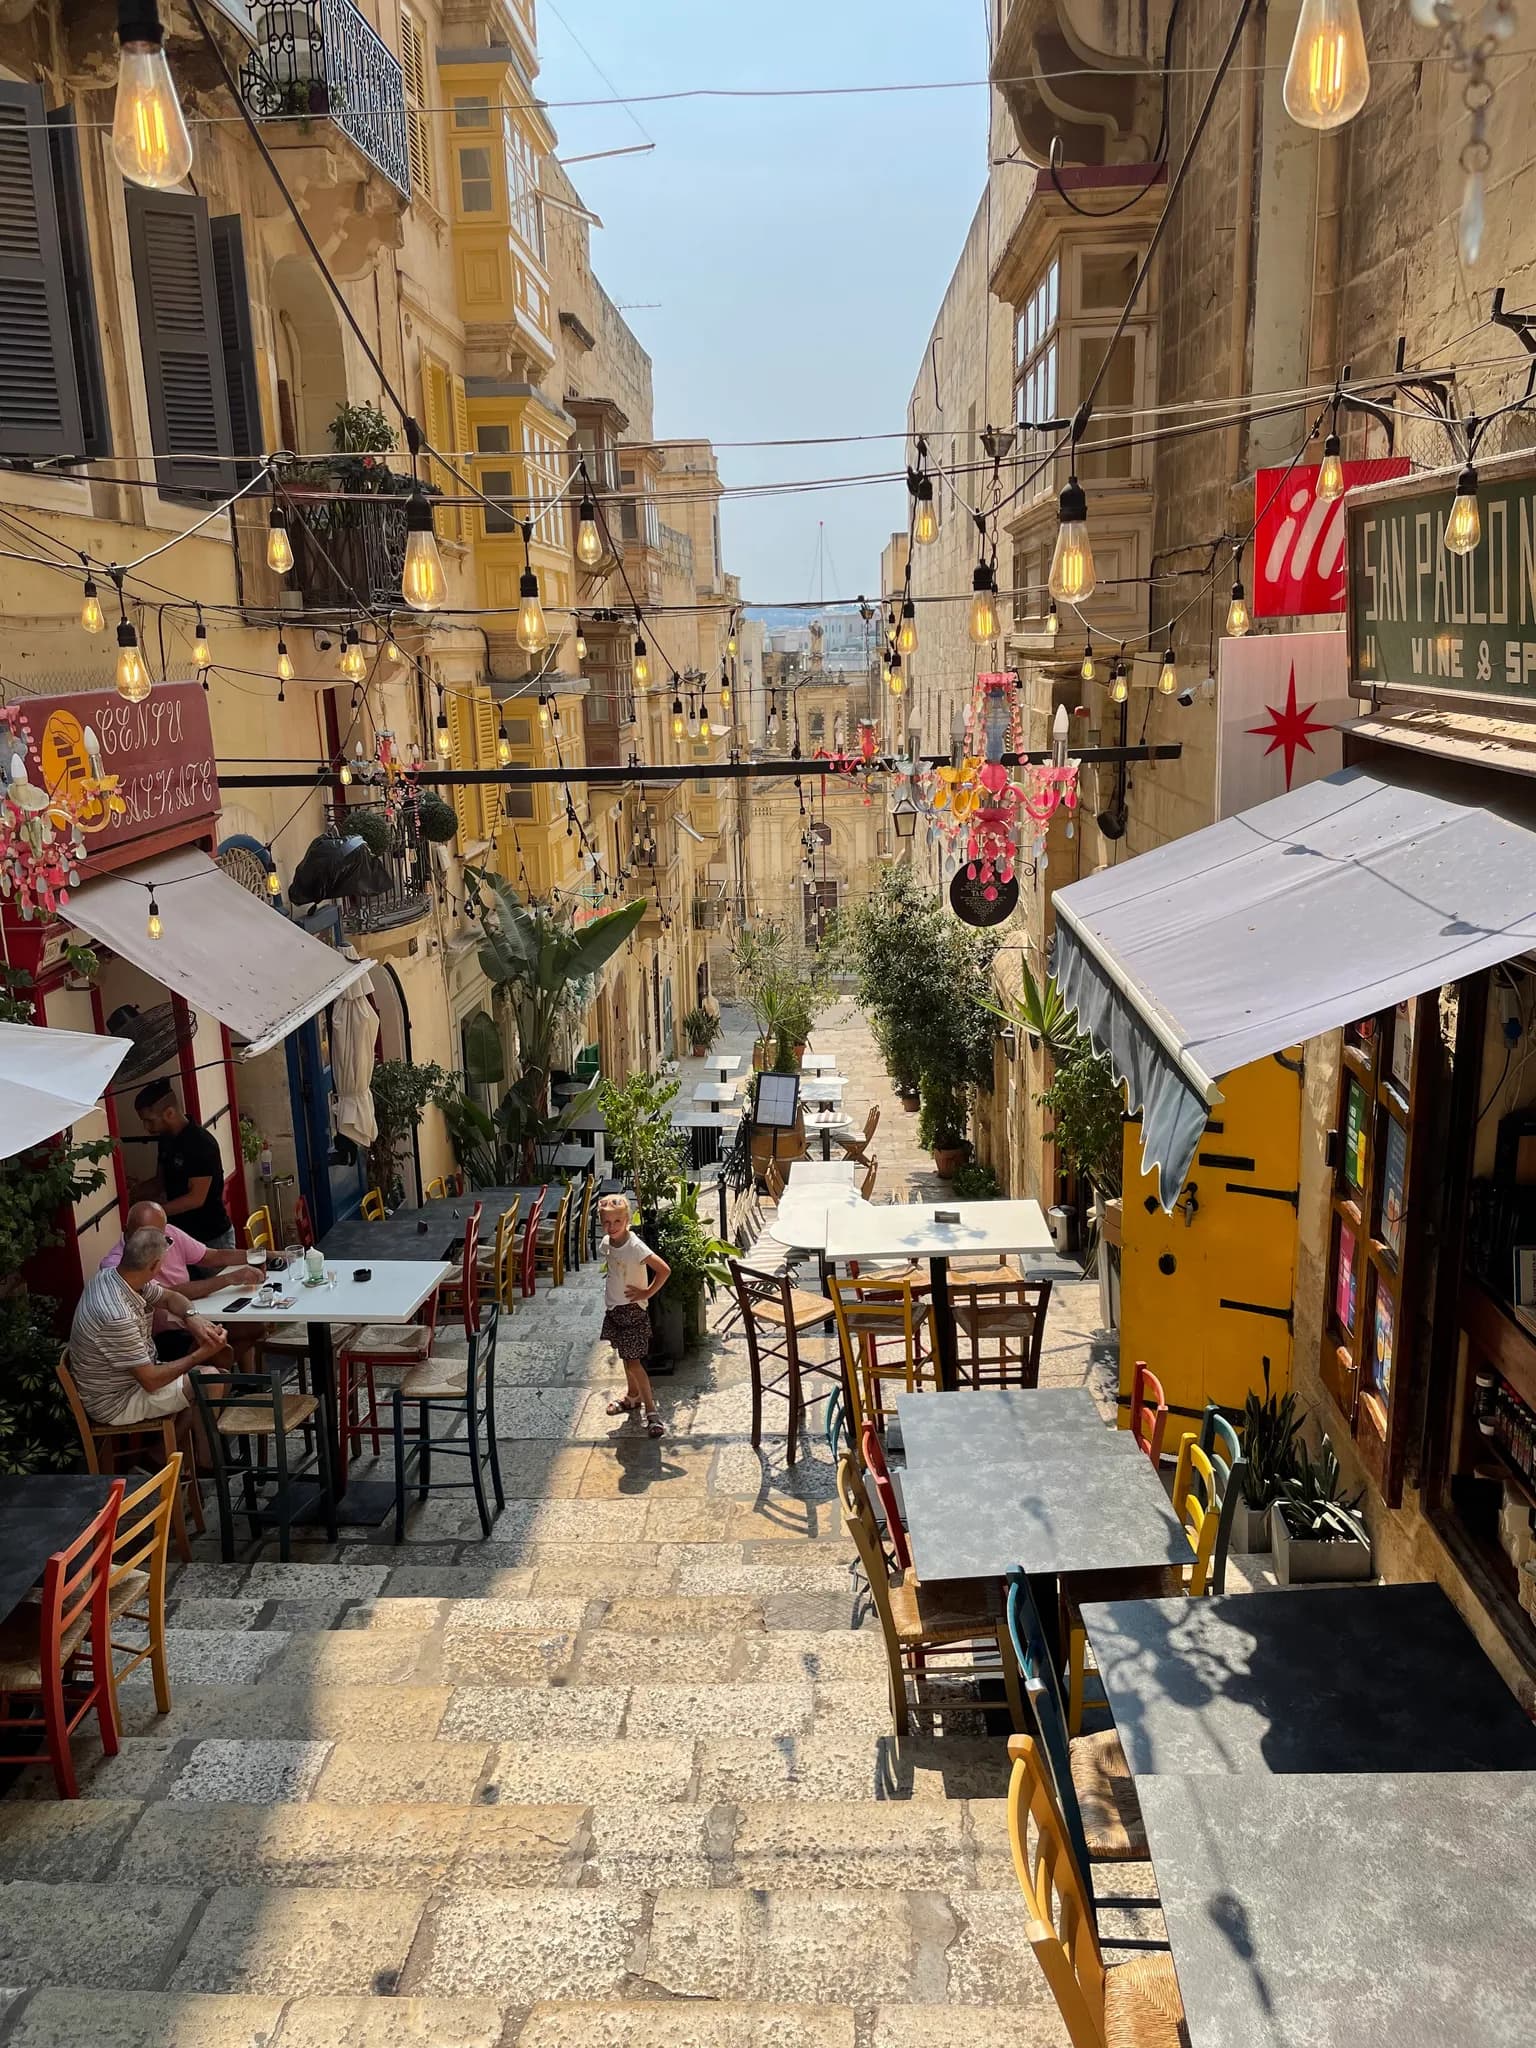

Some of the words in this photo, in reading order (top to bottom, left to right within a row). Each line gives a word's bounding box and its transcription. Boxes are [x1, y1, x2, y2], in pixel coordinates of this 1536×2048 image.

[1265, 489, 1345, 600] ill
[1364, 516, 1407, 621] SAN
[1411, 637, 1464, 678] WINE
[1476, 640, 1492, 681] &
